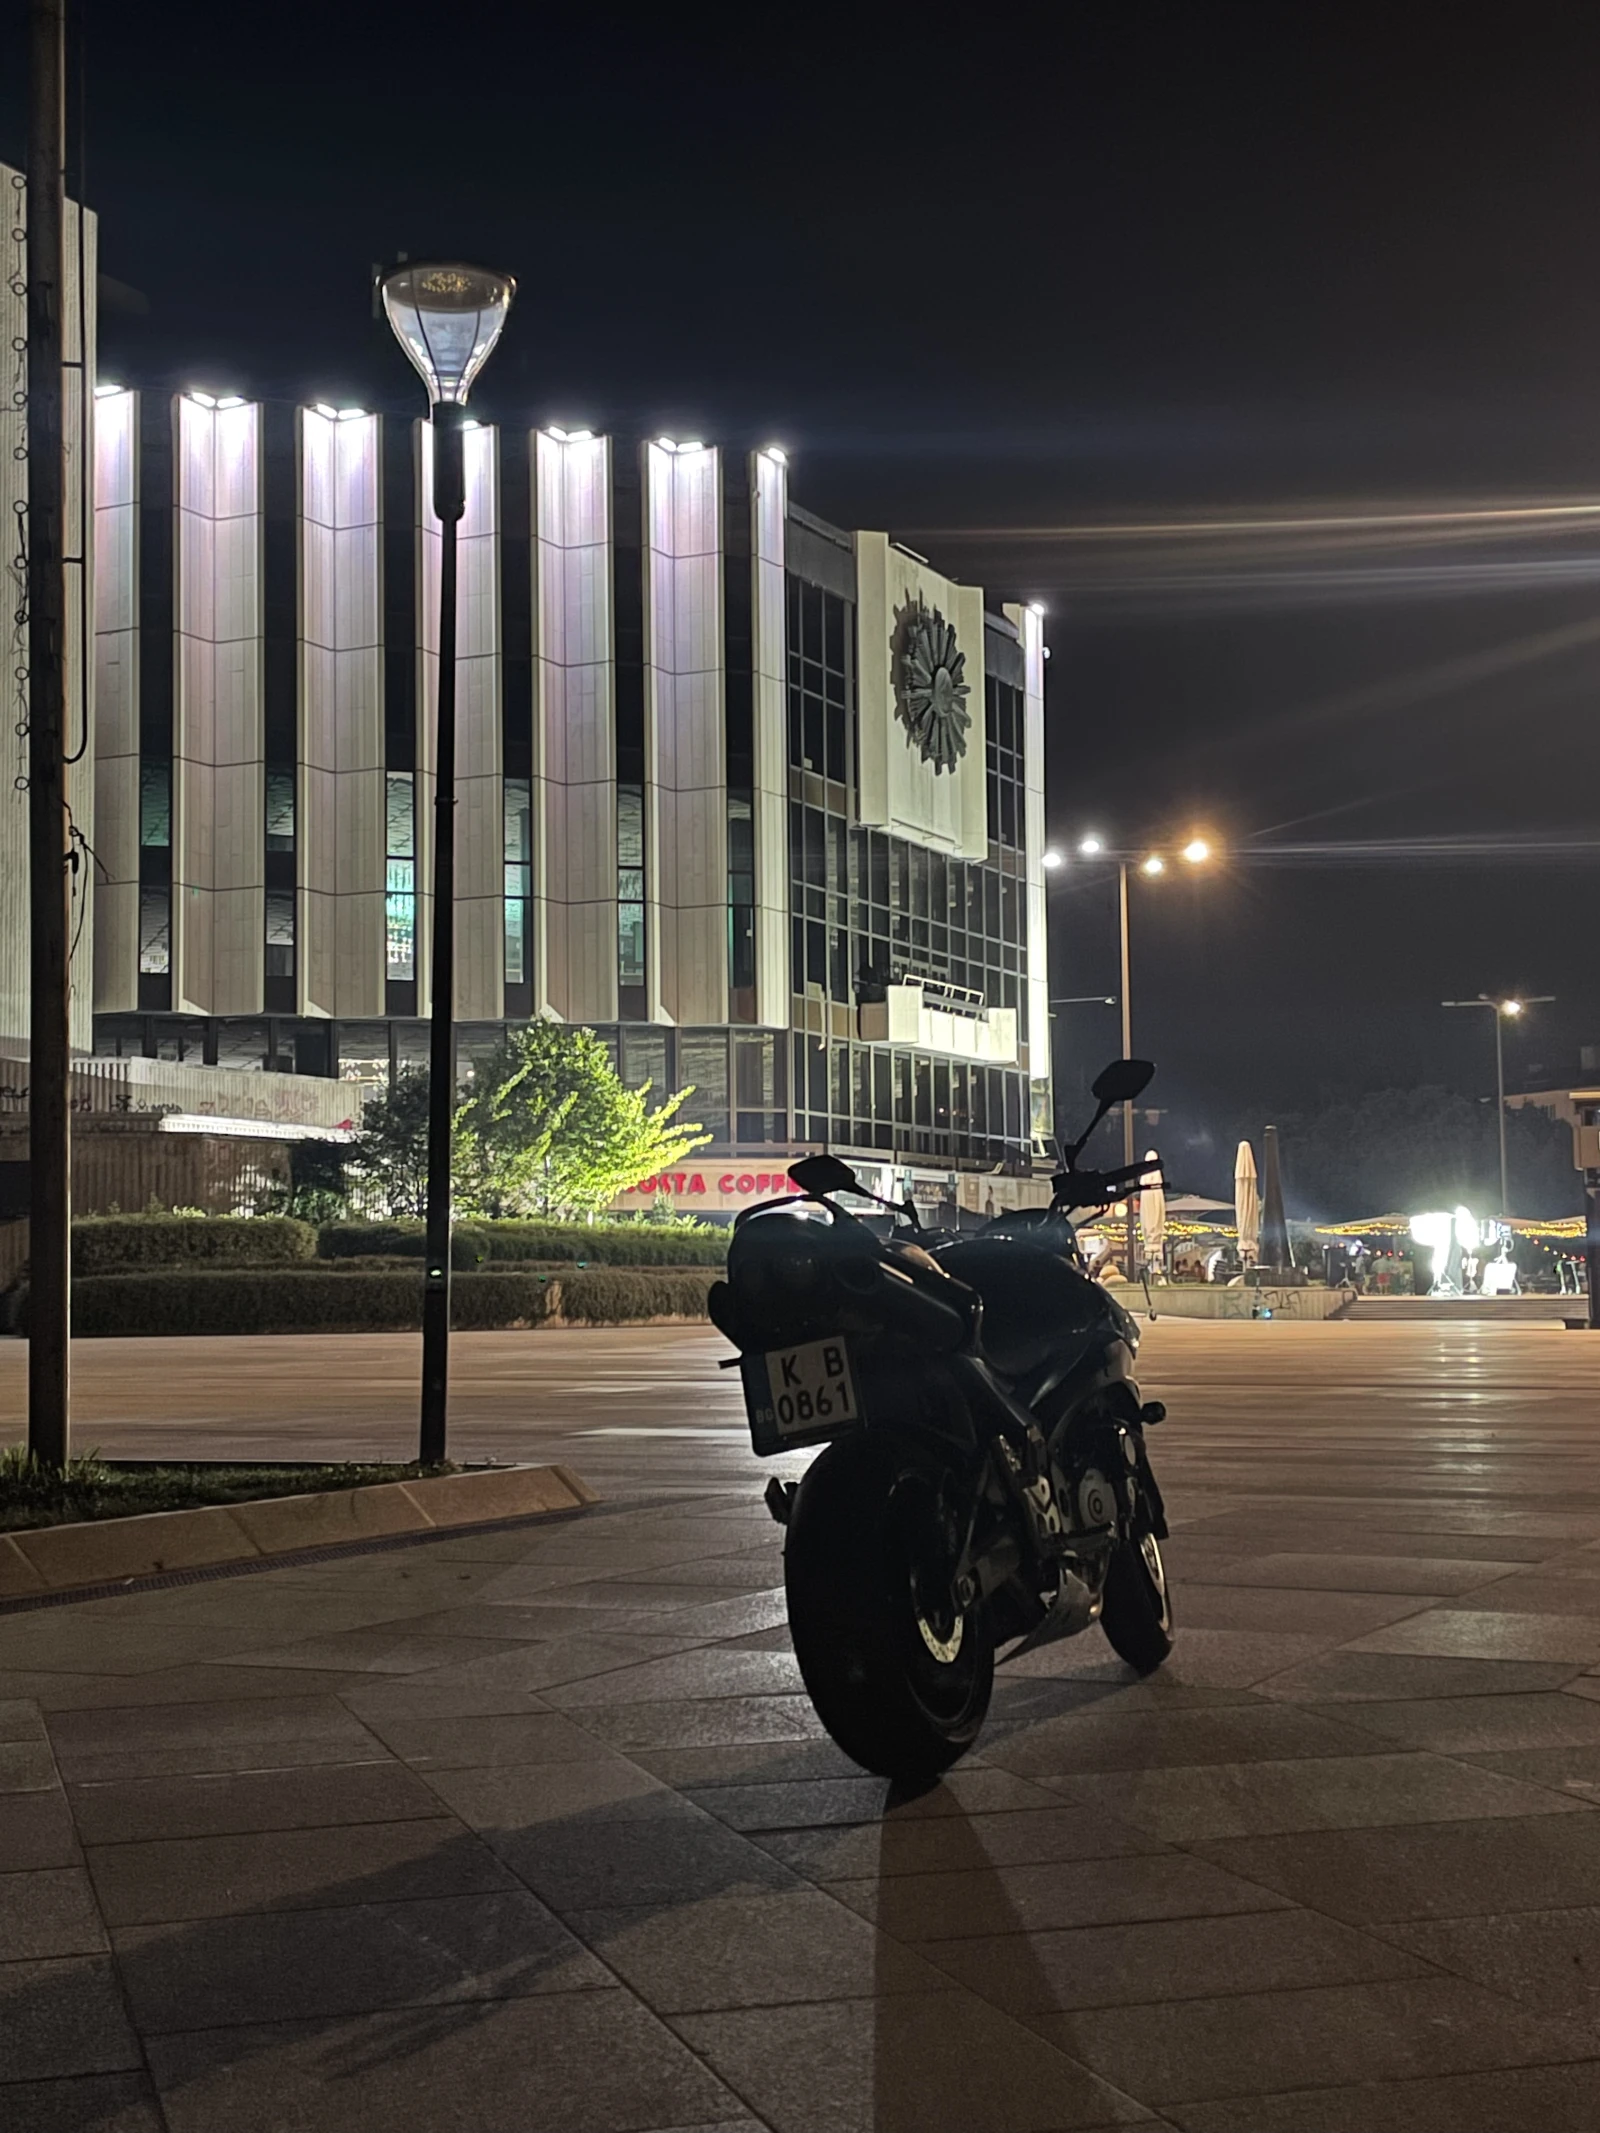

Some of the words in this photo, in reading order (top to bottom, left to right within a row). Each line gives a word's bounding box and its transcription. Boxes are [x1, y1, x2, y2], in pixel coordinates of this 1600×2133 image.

[622, 1173, 706, 1194] OSTA
[781, 1354, 802, 1388] K
[823, 1346, 844, 1378] B
[778, 1382, 849, 1425] 0861
